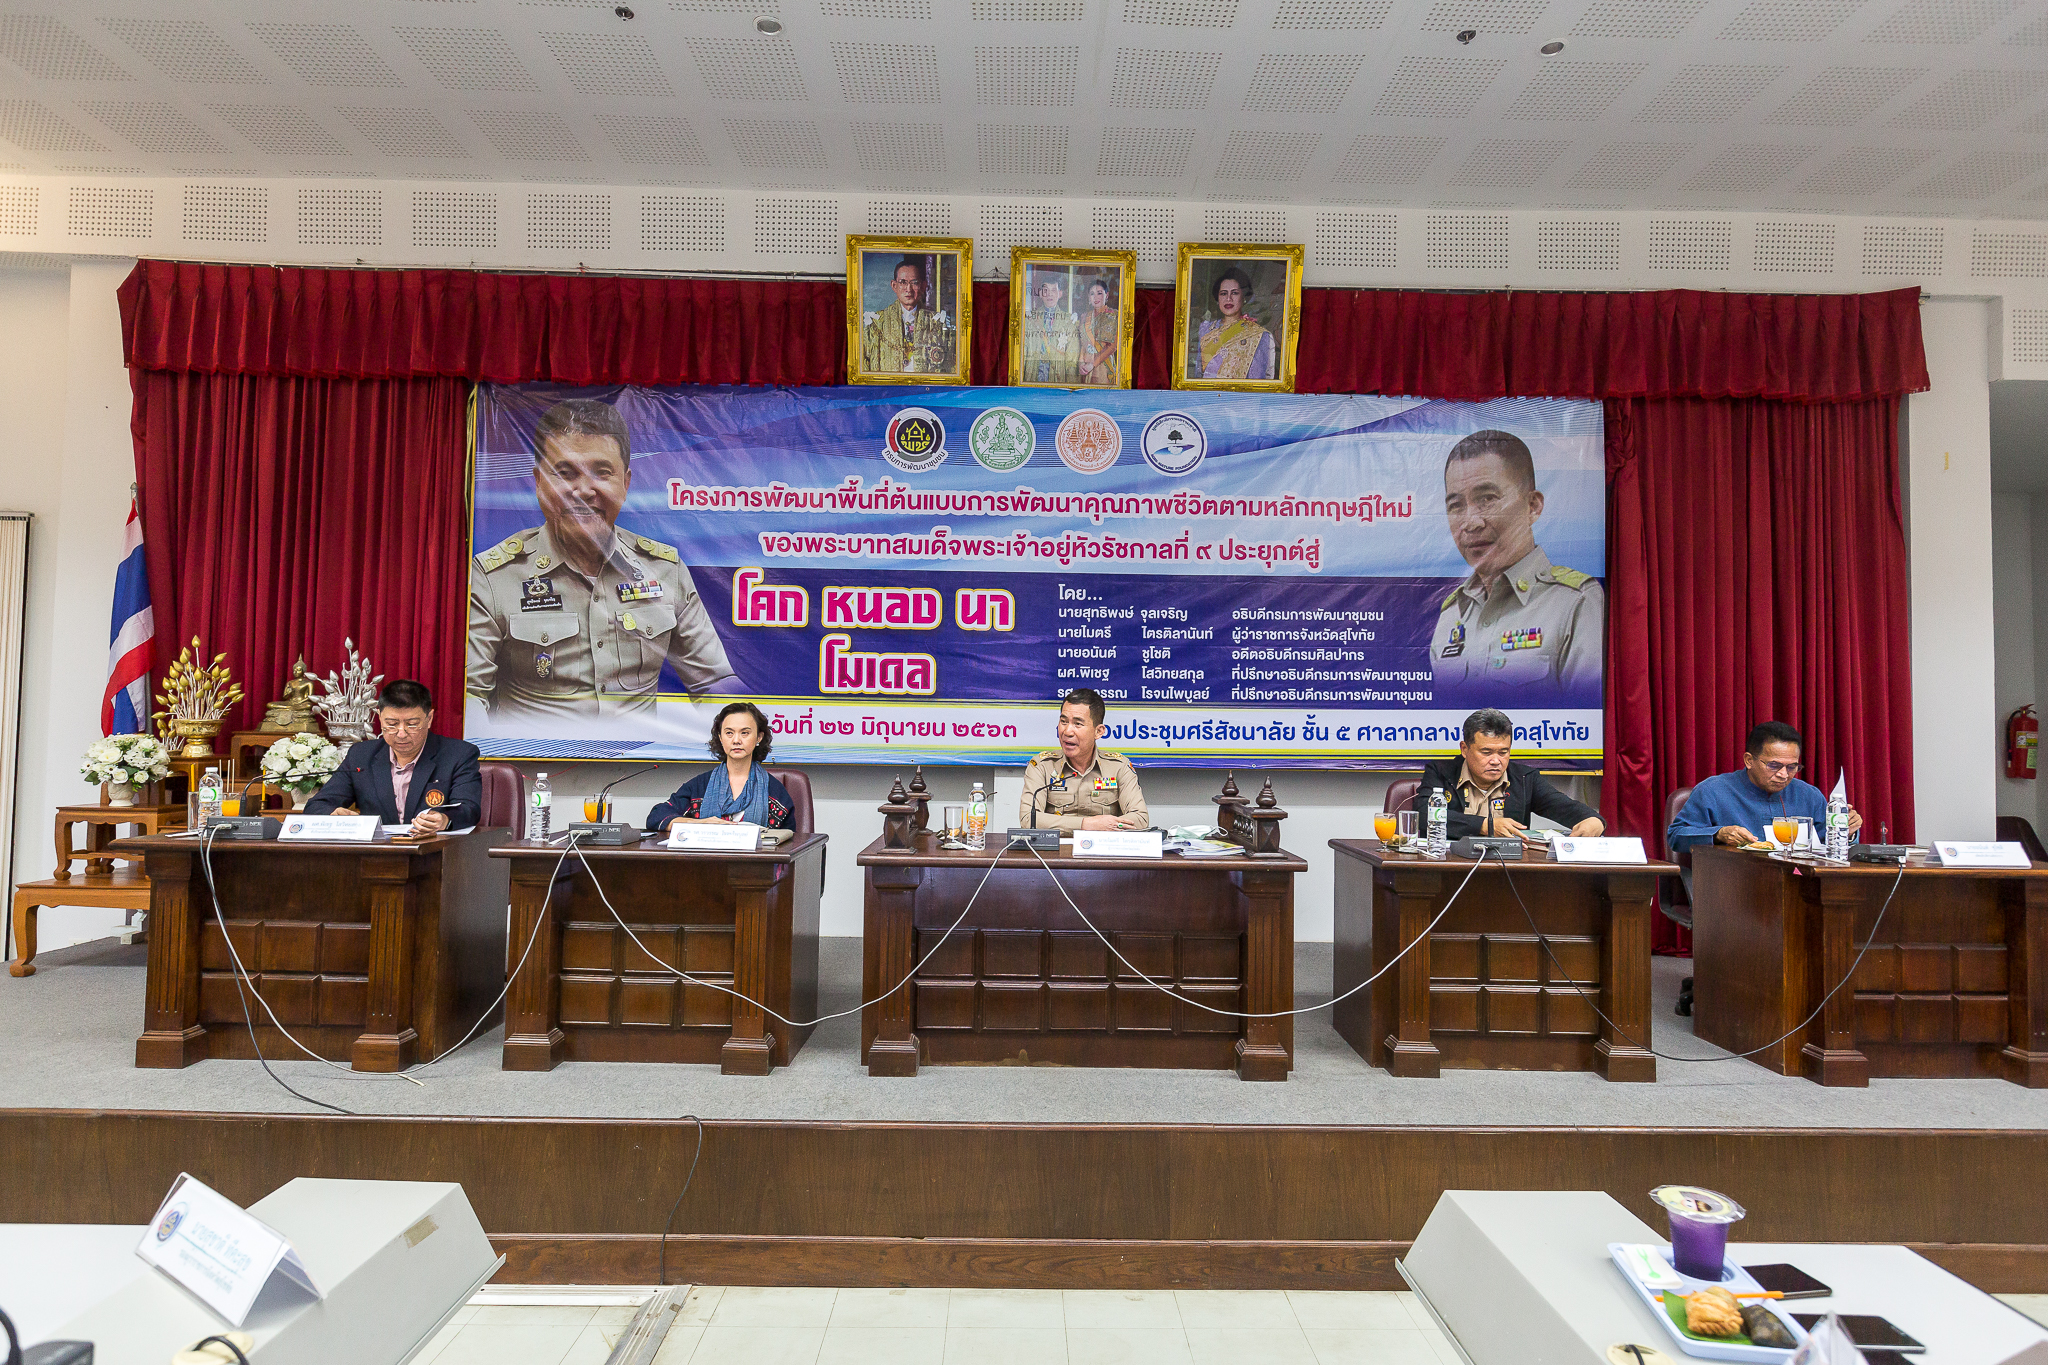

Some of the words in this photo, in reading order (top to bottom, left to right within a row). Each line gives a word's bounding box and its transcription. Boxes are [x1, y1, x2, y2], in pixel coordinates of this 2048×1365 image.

[884, 449, 946, 471] กรมการพัฒนาชุมชน
[671, 479, 1413, 523] โครงการพัฒนาพื้นที่ต้นแบบการพัฒนาคุณภาพชีวิตตามหลักทฤษฎีใหม่
[762, 529, 1190, 566] ของพระบาทสมเด็จพระเจ้าอยู่หัวรัชกาลที่
[1196, 543, 1212, 561] ๙
[1219, 537, 1322, 569] ประยุกต์สู่
[735, 569, 807, 624] โคก
[824, 588, 940, 627] หนอง
[958, 591, 1013, 629] นา
[1058, 583, 1103, 602] โดย...
[1058, 605, 1135, 623] นายสุทธิพงษ์
[1140, 607, 1188, 623] จุลเจริญ
[1232, 607, 1384, 625] อธิบดีกรมการพัฒนาชุมชน
[1058, 625, 1112, 639] นายไมตรี
[1141, 626, 1214, 640] ไตรติลานันท์
[1231, 626, 1376, 645] ผู้ว่าราชการจังหวัดสุโขทัย
[822, 636, 934, 692] โมเดล
[1057, 645, 1117, 659] นายอนันต์
[1141, 645, 1171, 663] ชูโชติ
[1231, 647, 1365, 661] อดีตอธิบดีกรมศิลปากร
[1057, 666, 1110, 682] ผศ.พิเชฐ
[1141, 665, 1205, 684] โสวิทยสกุล
[1231, 664, 1432, 686] ที่ปรึกษาอธิบดีกรมการพัฒนาชุมชน
[1141, 685, 1210, 703] โรจนไพบูลย์
[1231, 683, 1432, 705] ที่ปรึกษาอธิบดีกรมการพัฒนาชุมชน
[771, 707, 813, 735] วันที่
[819, 720, 855, 736] ๒๒
[861, 716, 946, 743] มิถุนายน
[952, 719, 1018, 738] ๒๕๖๓
[1302, 714, 1329, 741] ชั้น
[1336, 726, 1351, 741] ๕
